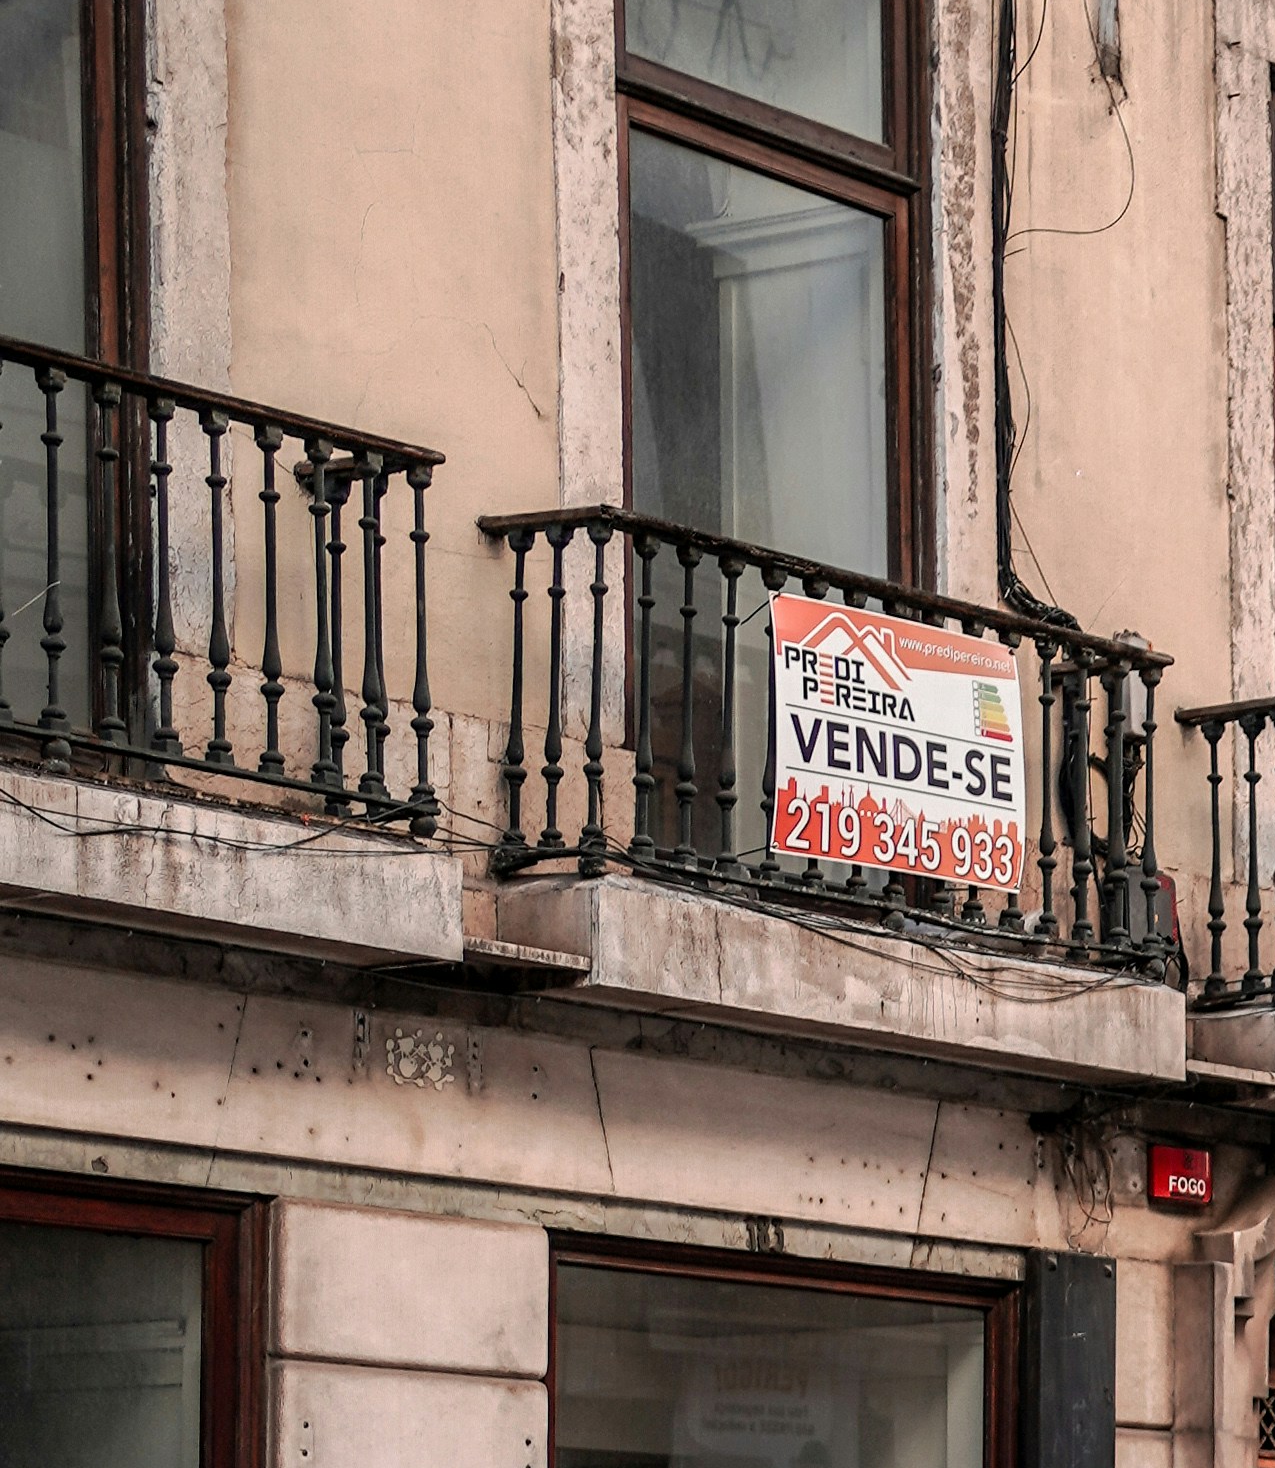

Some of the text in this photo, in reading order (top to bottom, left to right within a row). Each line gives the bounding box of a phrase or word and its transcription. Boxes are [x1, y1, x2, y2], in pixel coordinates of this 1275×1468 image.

[784, 645, 865, 685] PREDI
[802, 675, 915, 722] PEREIRA
[790, 713, 1013, 802] VENDE-SE
[785, 798, 1014, 884] 219 345 933
[1168, 1175, 1206, 1196] FOGO
